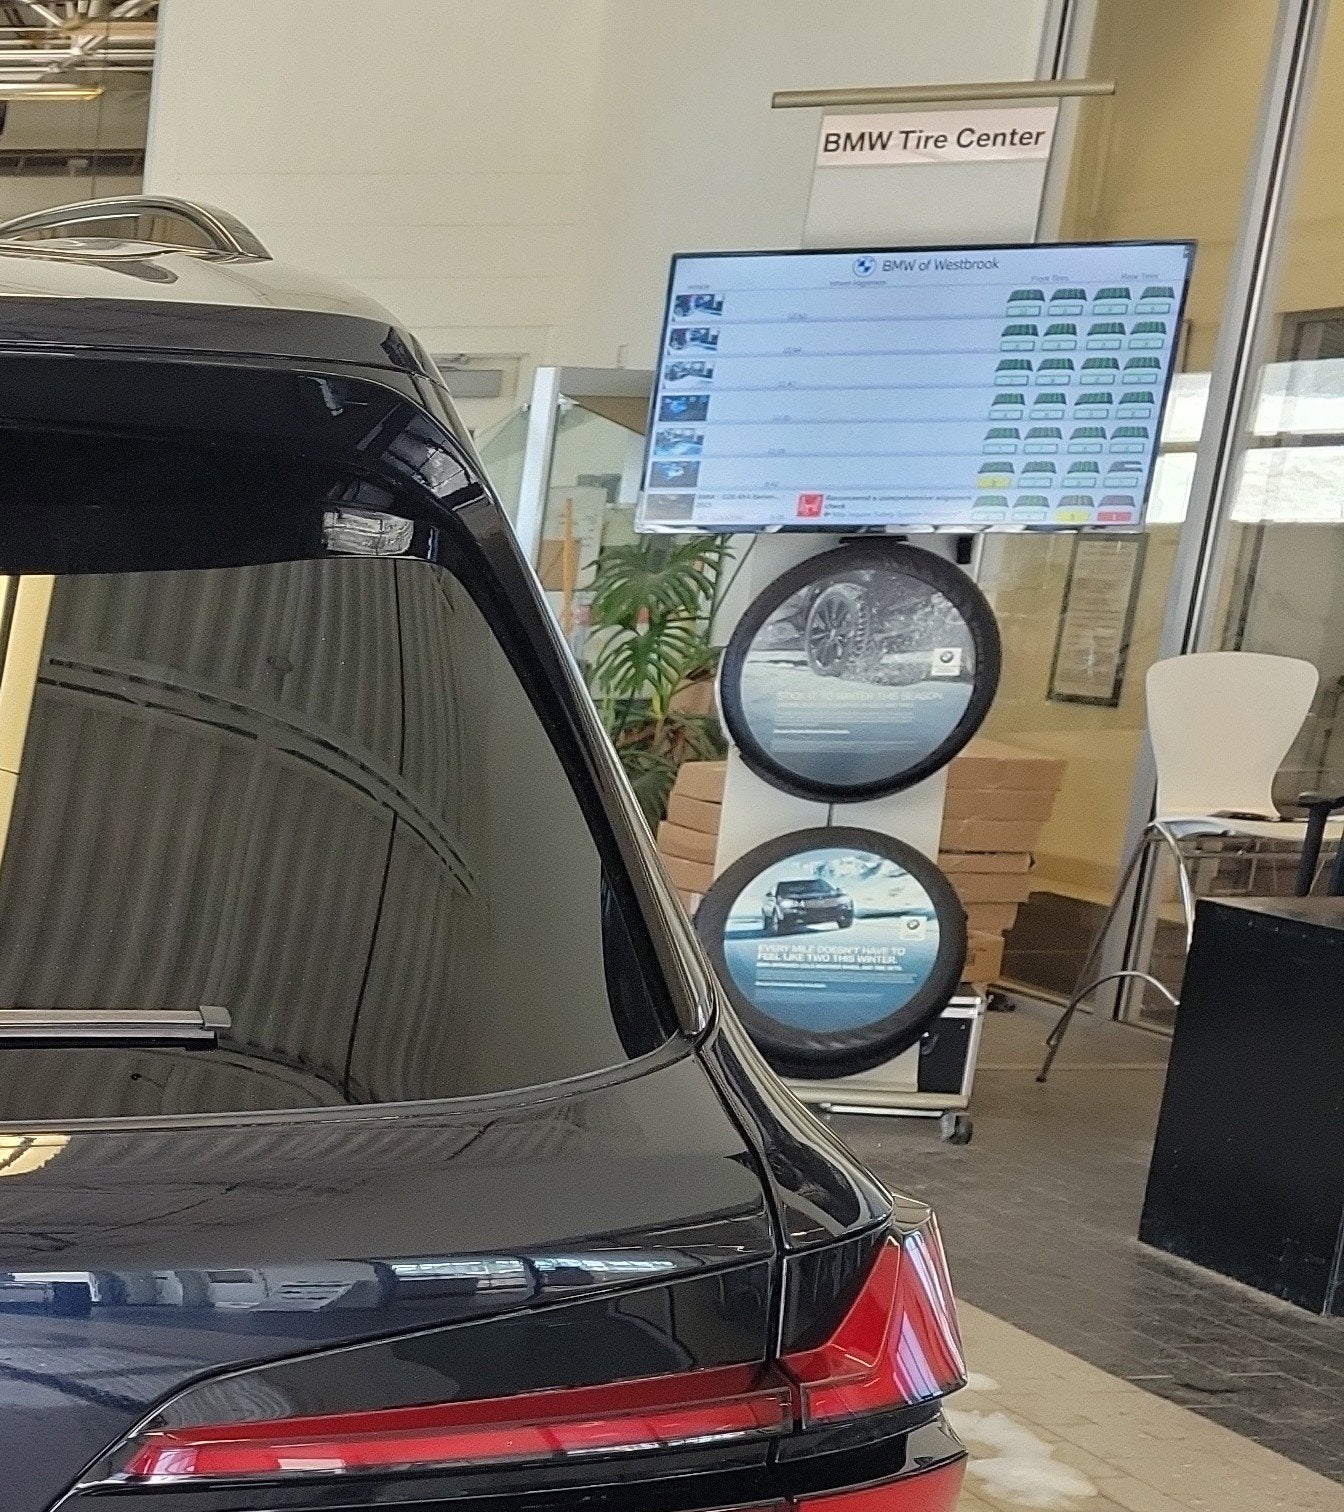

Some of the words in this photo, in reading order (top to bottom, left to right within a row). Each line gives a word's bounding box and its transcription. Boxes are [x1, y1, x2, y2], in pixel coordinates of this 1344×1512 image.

[823, 130, 892, 153] BMW
[899, 129, 948, 150] Tire
[956, 127, 1046, 149] Center
[882, 259, 917, 272] BMW
[918, 257, 931, 271] of
[933, 257, 1000, 271] Westbrook
[757, 944, 788, 953] EVERY
[791, 945, 813, 954] MILE
[862, 946, 889, 955] HAVE
[890, 947, 906, 956] TO
[757, 953, 781, 961] FEEL
[783, 953, 806, 962] LIKE
[807, 954, 830, 962] TWO
[832, 954, 855, 963] THIS
